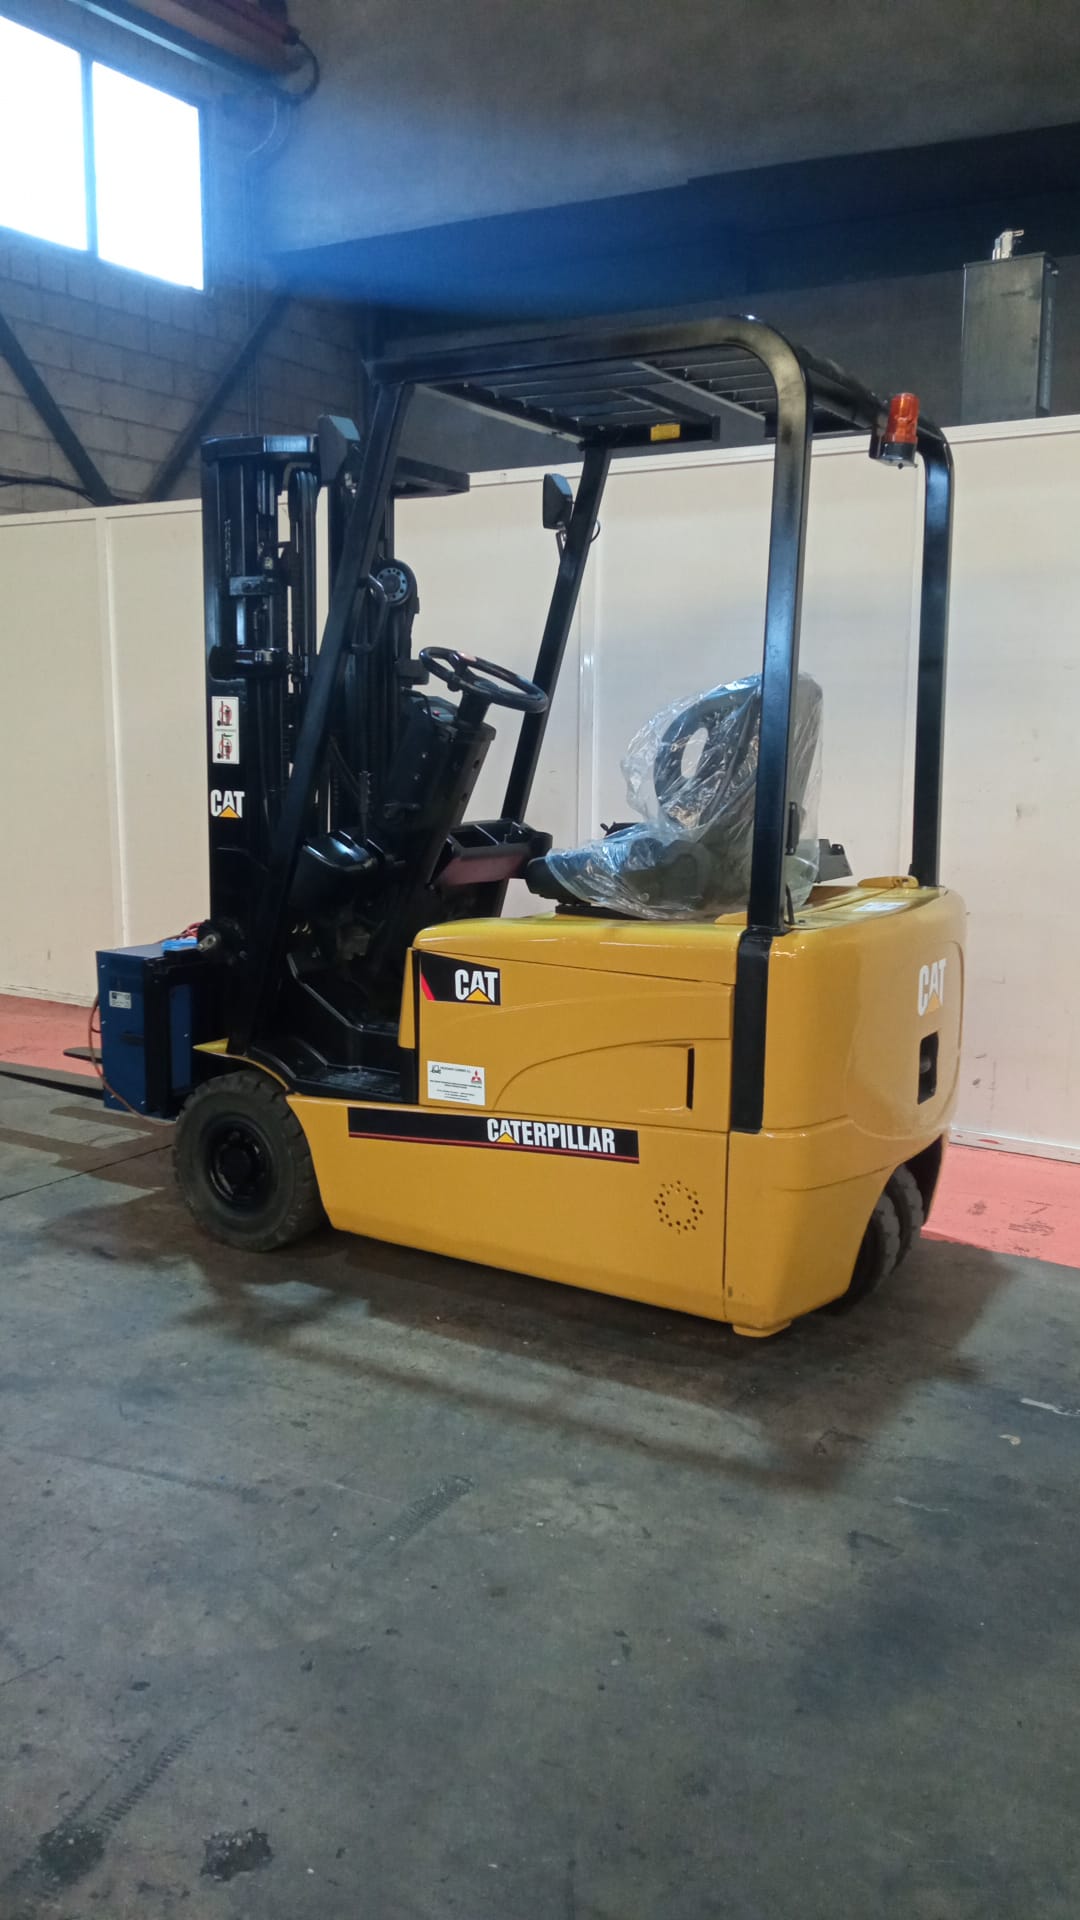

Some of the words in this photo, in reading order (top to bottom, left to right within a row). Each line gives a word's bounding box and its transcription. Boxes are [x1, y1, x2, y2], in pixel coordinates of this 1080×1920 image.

[211, 790, 245, 818] CAT
[455, 969, 498, 1003] CAT
[919, 958, 948, 1016] CAT
[488, 1119, 616, 1154] CATERPILLAR
